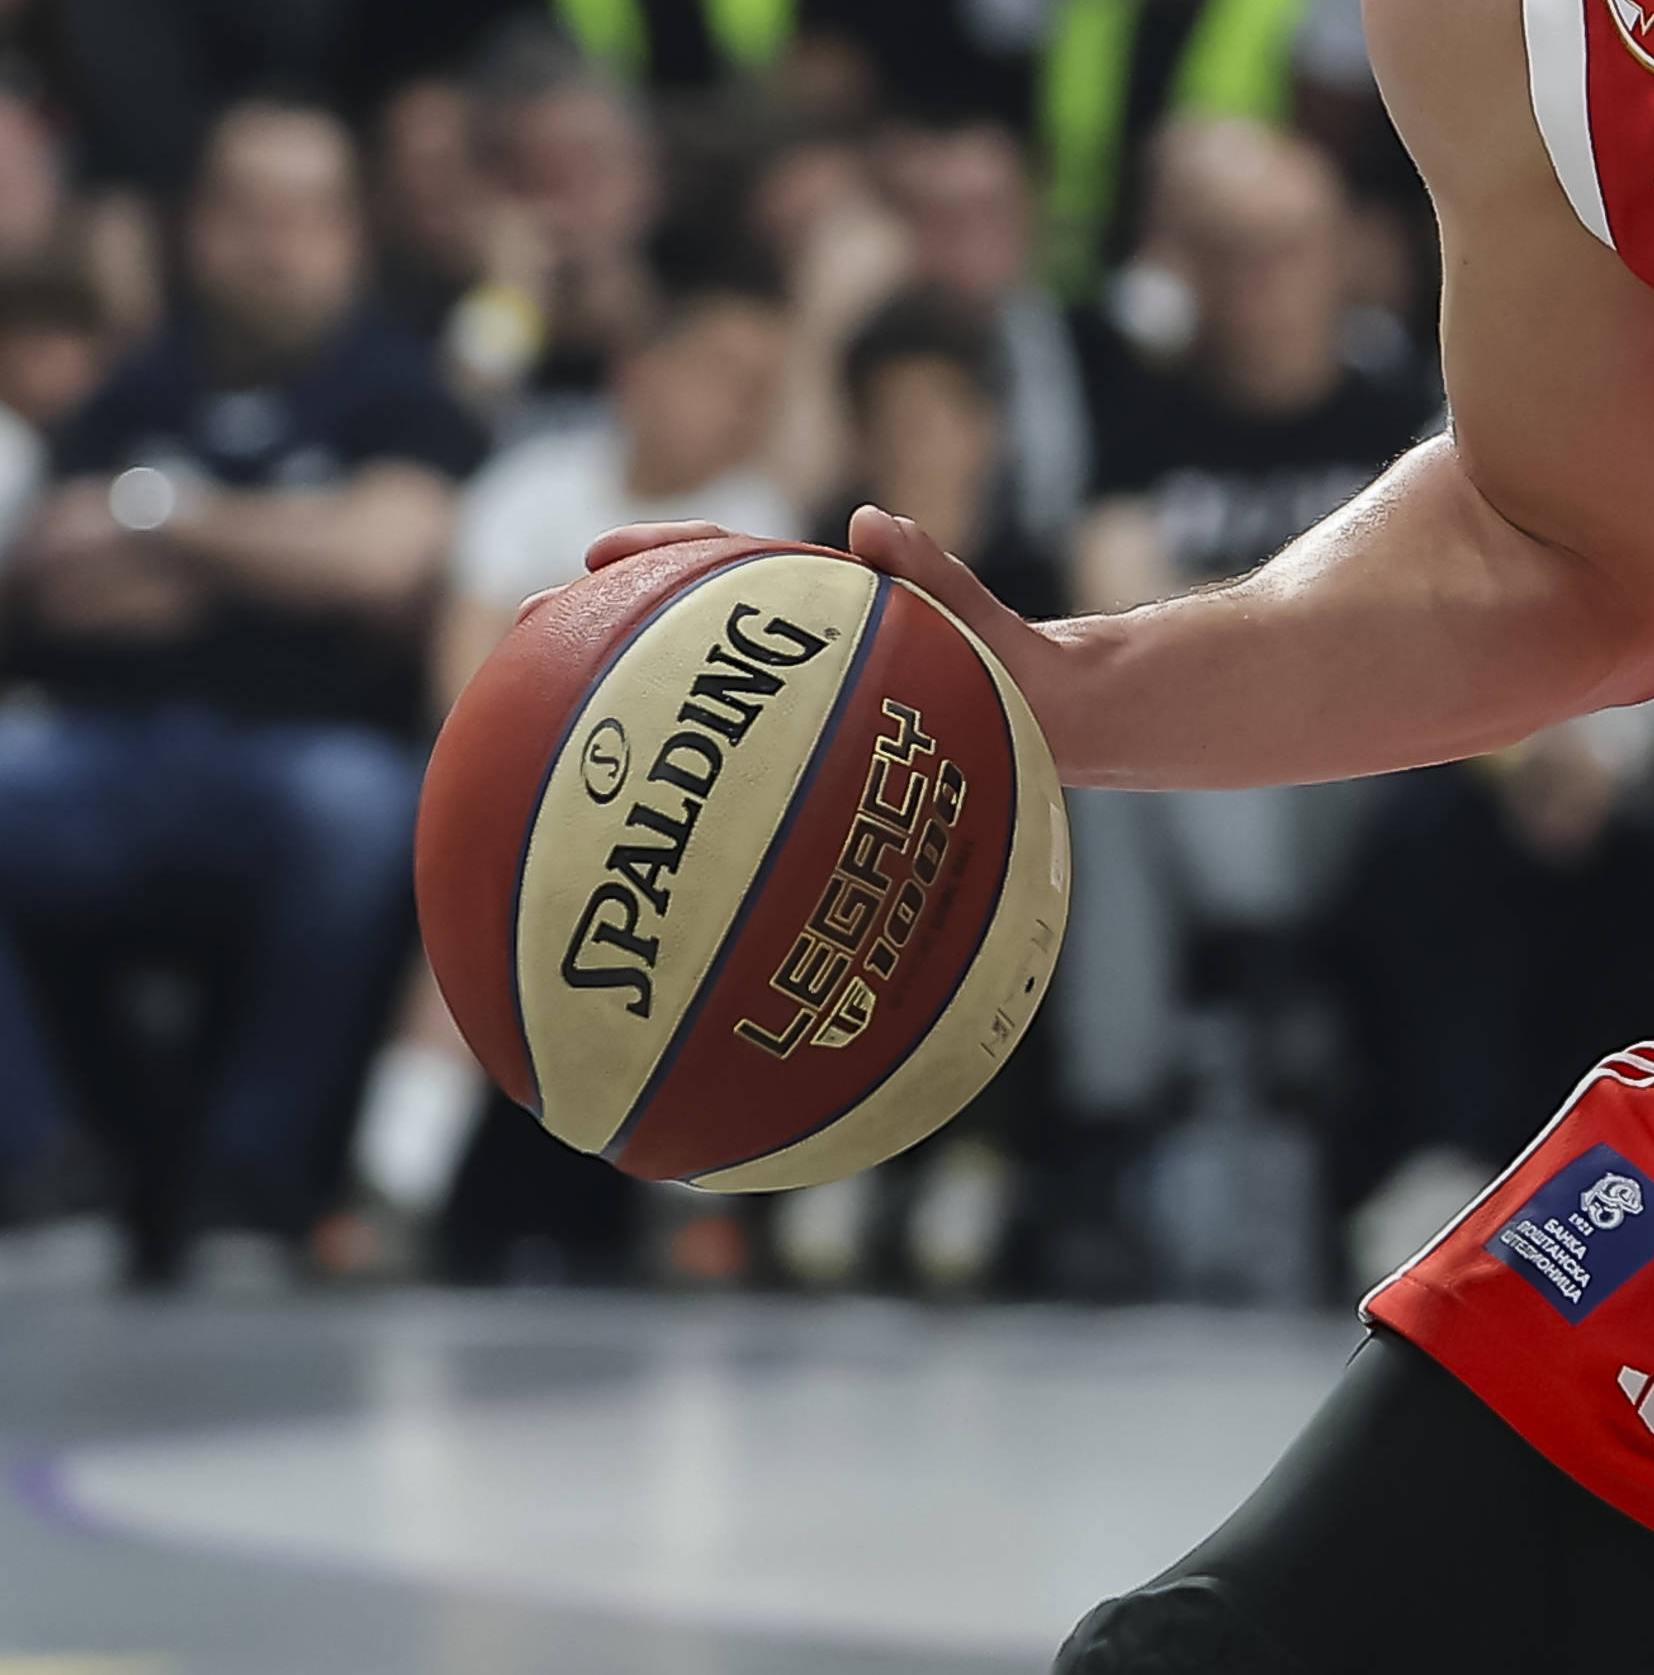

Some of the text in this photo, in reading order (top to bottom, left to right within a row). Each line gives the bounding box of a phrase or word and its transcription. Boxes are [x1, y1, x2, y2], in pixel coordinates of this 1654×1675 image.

[560, 601, 830, 1018] SPALDING
[733, 698, 936, 1059] LEGACY
[863, 759, 967, 981] 1000
[1516, 1220, 1591, 1289] ПОШТАНСКА
[1543, 1218, 1588, 1260] БАНКА
